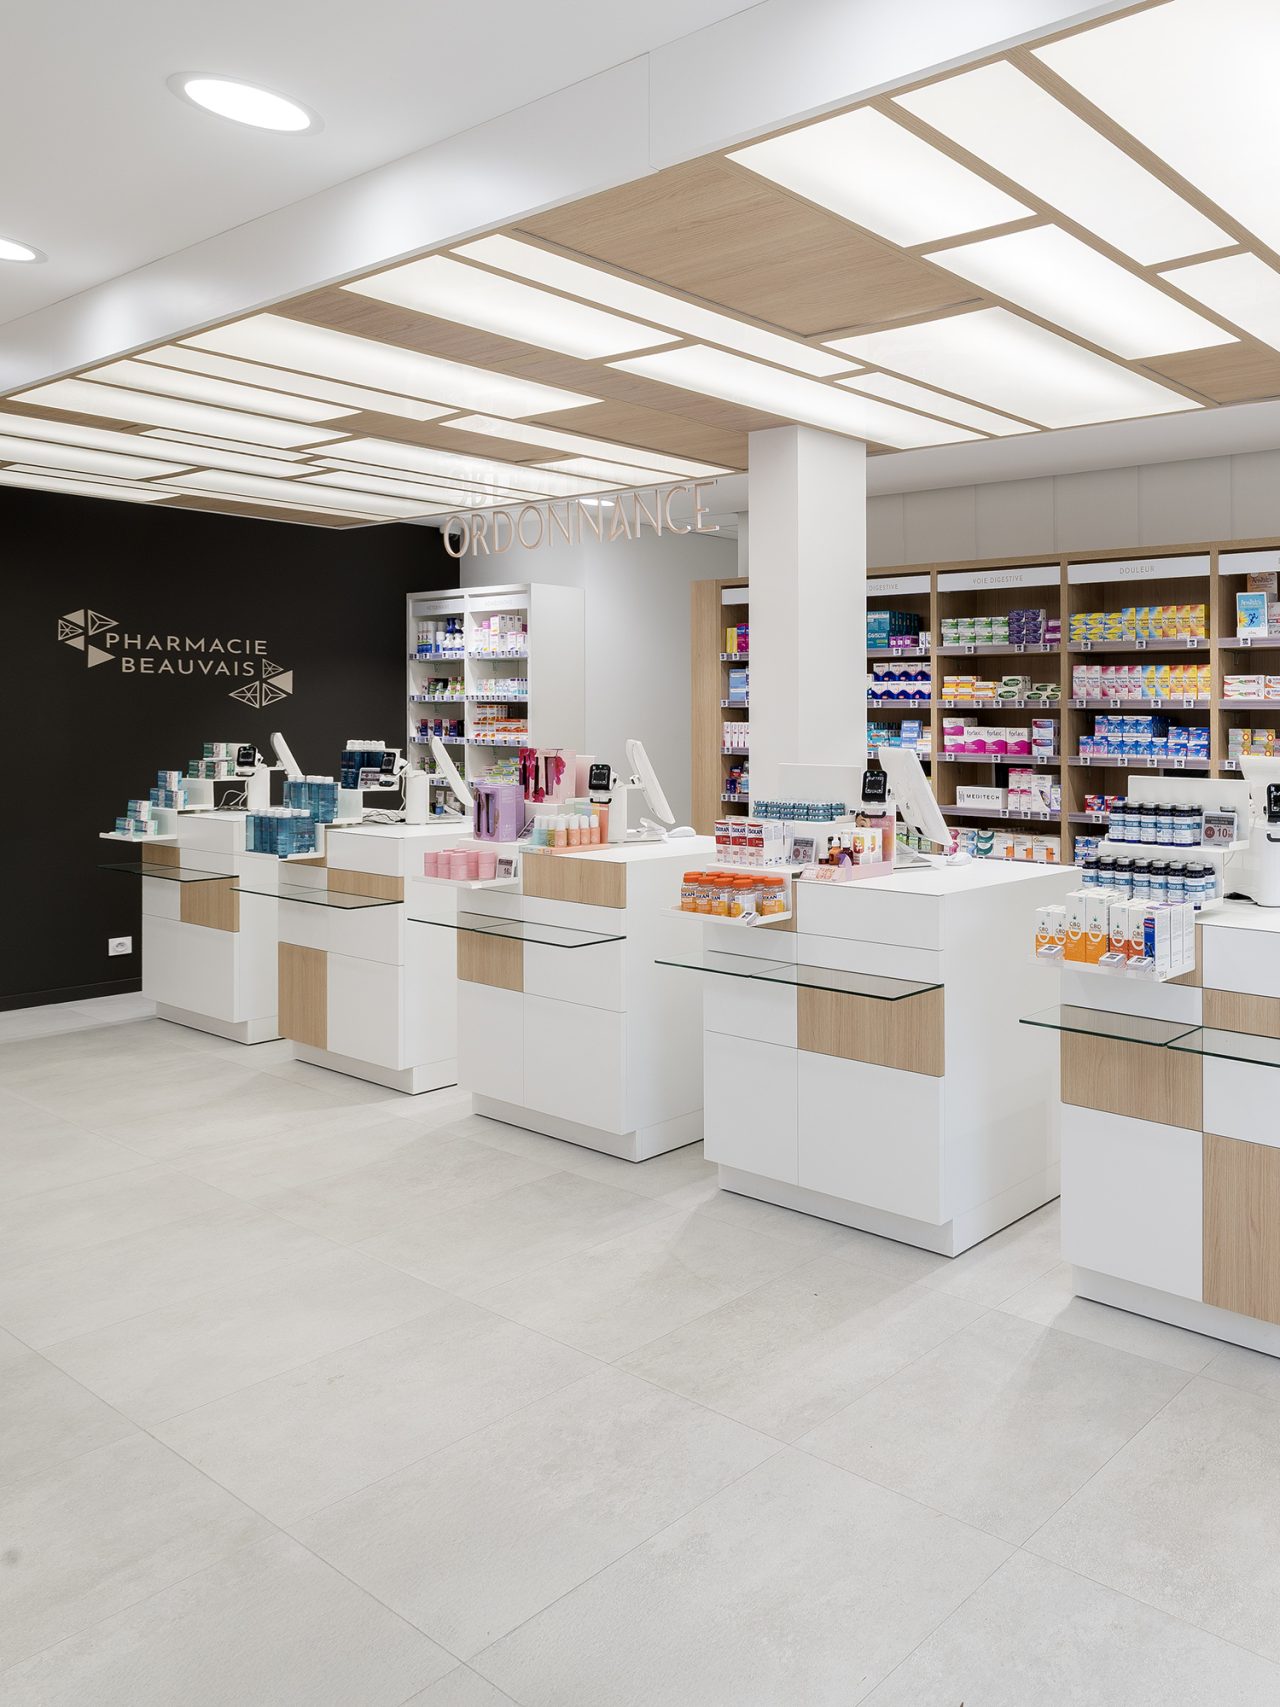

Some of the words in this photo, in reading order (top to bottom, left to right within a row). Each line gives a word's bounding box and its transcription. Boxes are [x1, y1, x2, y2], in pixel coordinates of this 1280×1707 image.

[444, 479, 720, 558] ORDONNANCE
[1119, 565, 1155, 575] DOULEUR
[972, 576, 988, 585] VOIE
[989, 574, 1024, 584] DIGESTIVE
[868, 583, 899, 592] DIGESTIVE
[106, 632, 268, 656] PHARMACIE
[121, 656, 255, 677] BEAUVAIS
[966, 793, 1001, 801] MEDITECH
